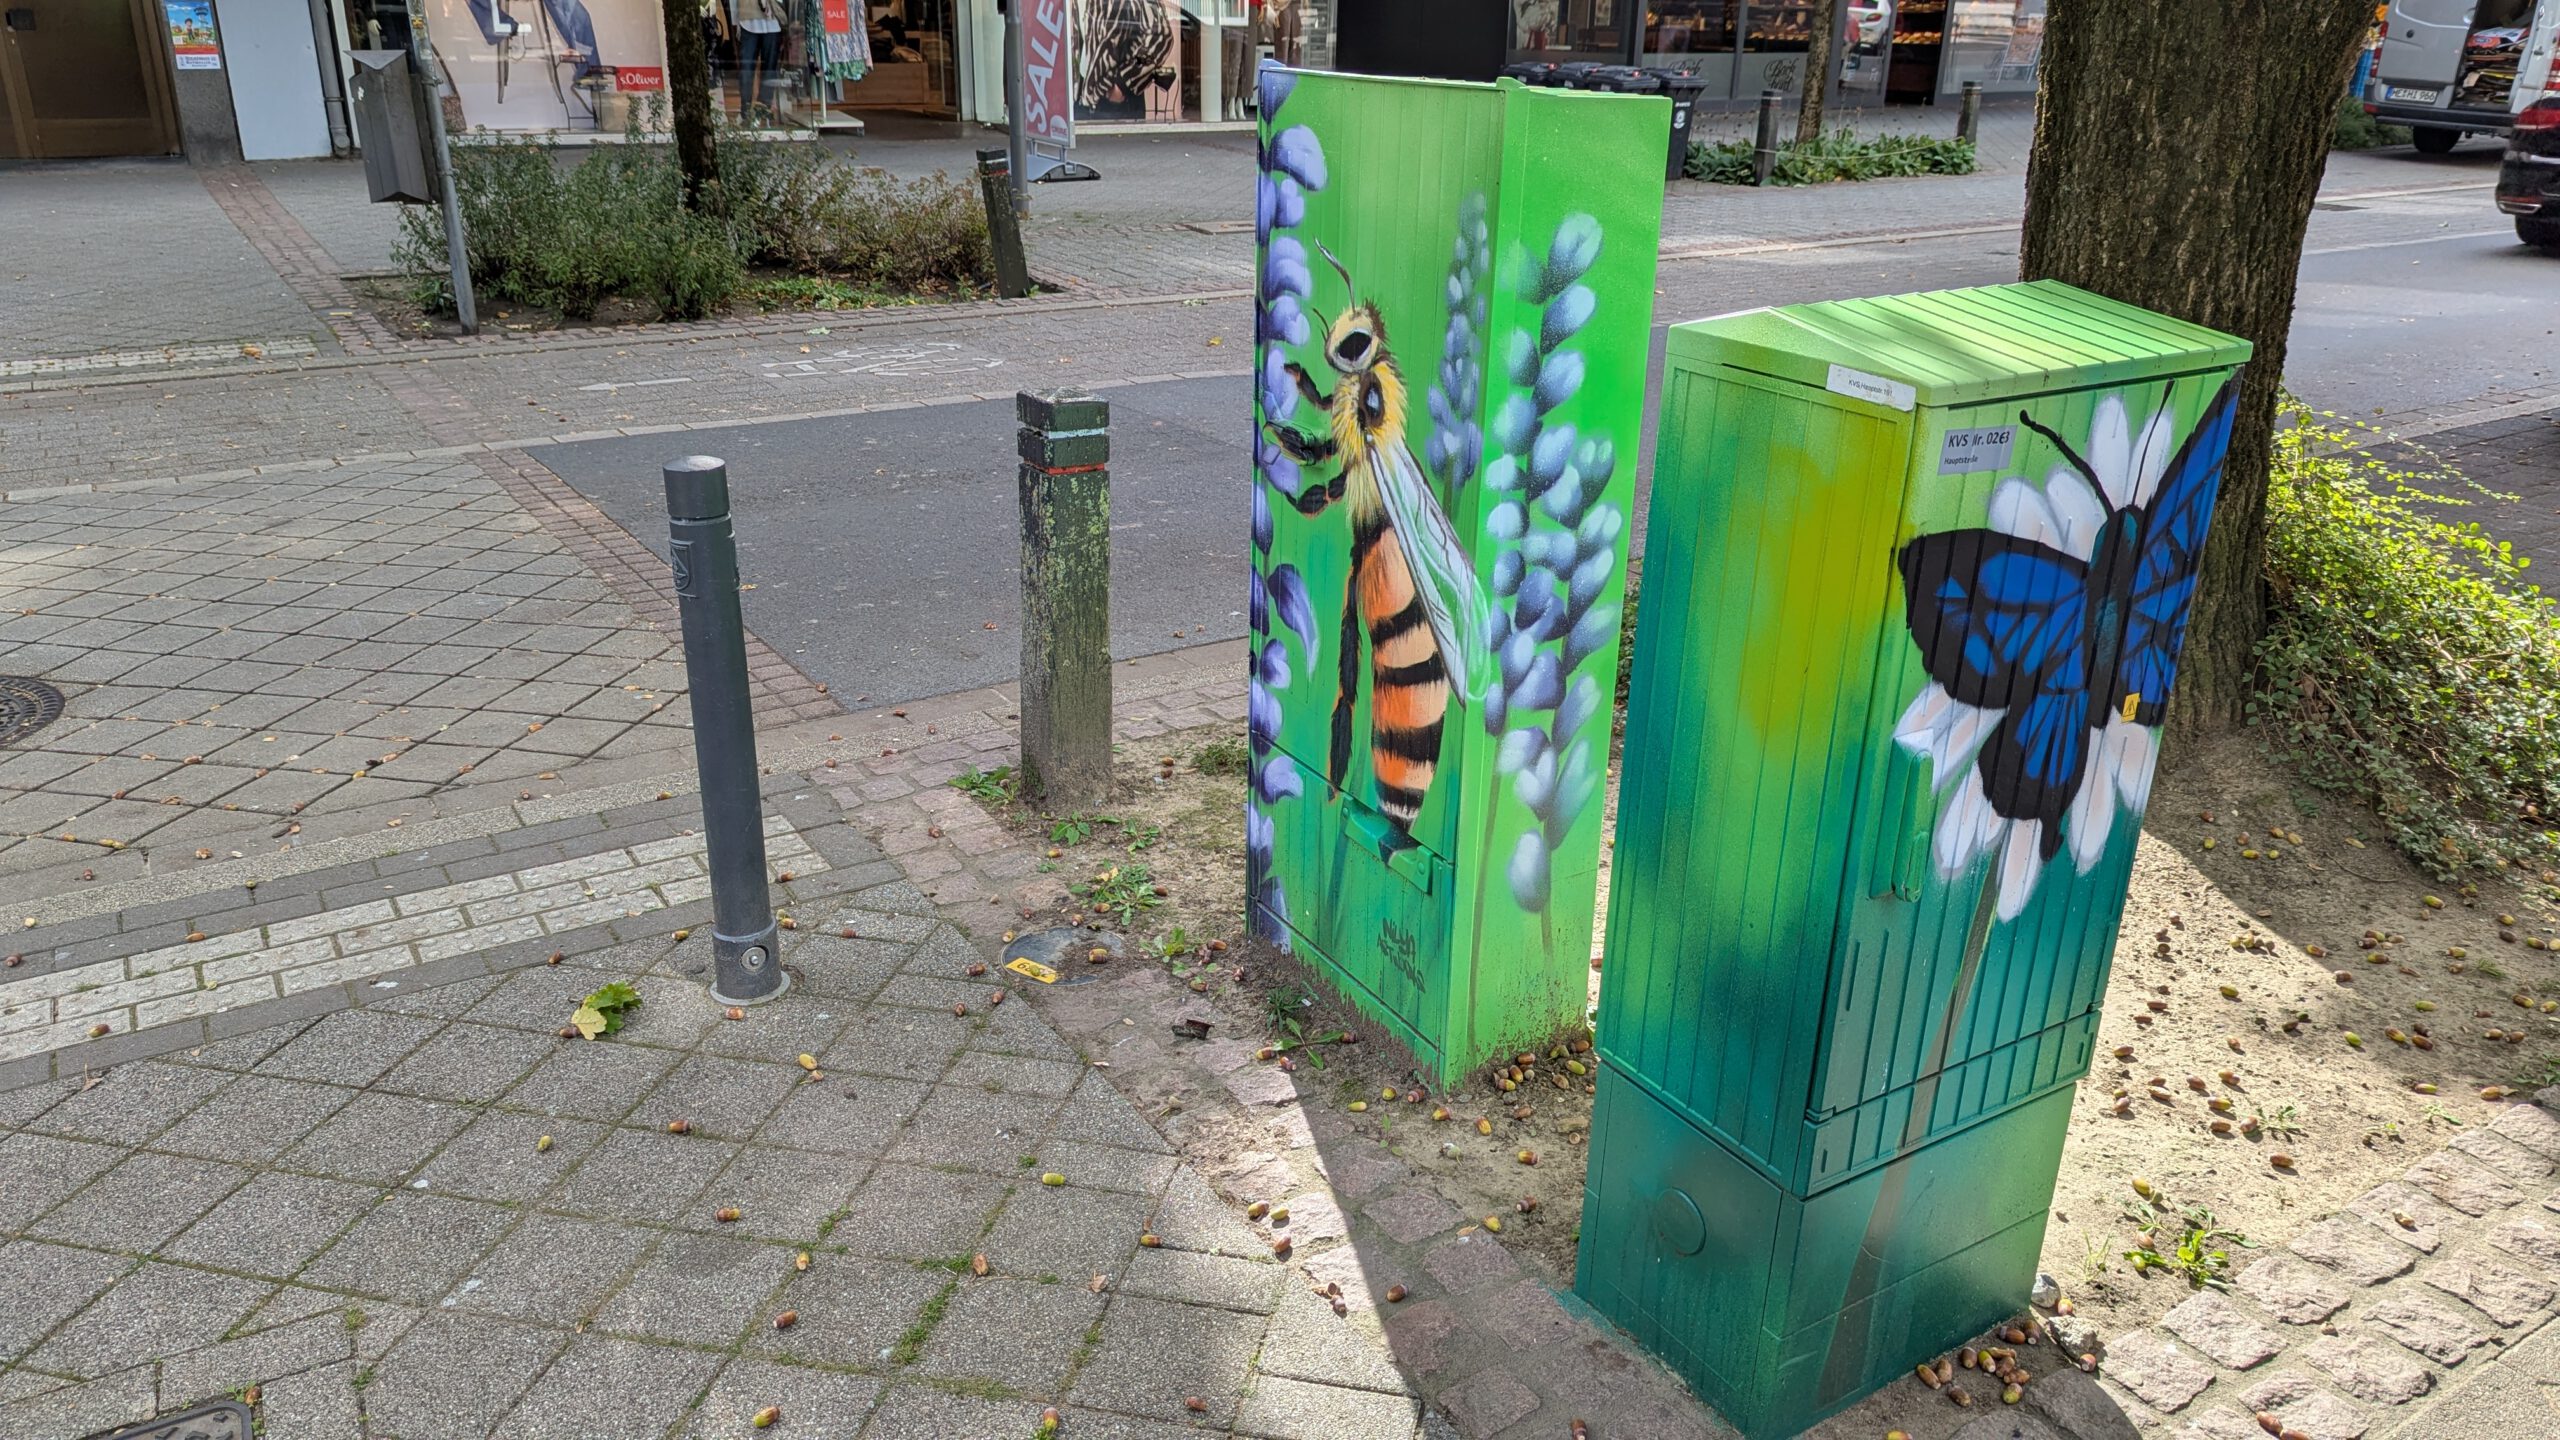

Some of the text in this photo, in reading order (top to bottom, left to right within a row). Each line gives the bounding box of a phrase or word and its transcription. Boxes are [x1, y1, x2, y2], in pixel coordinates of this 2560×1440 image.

[1025, 0, 1064, 133] SALE
[620, 72, 660, 86] s.Oliver
[1948, 434, 1969, 448] KVS
[1986, 430, 2010, 445] 0263
